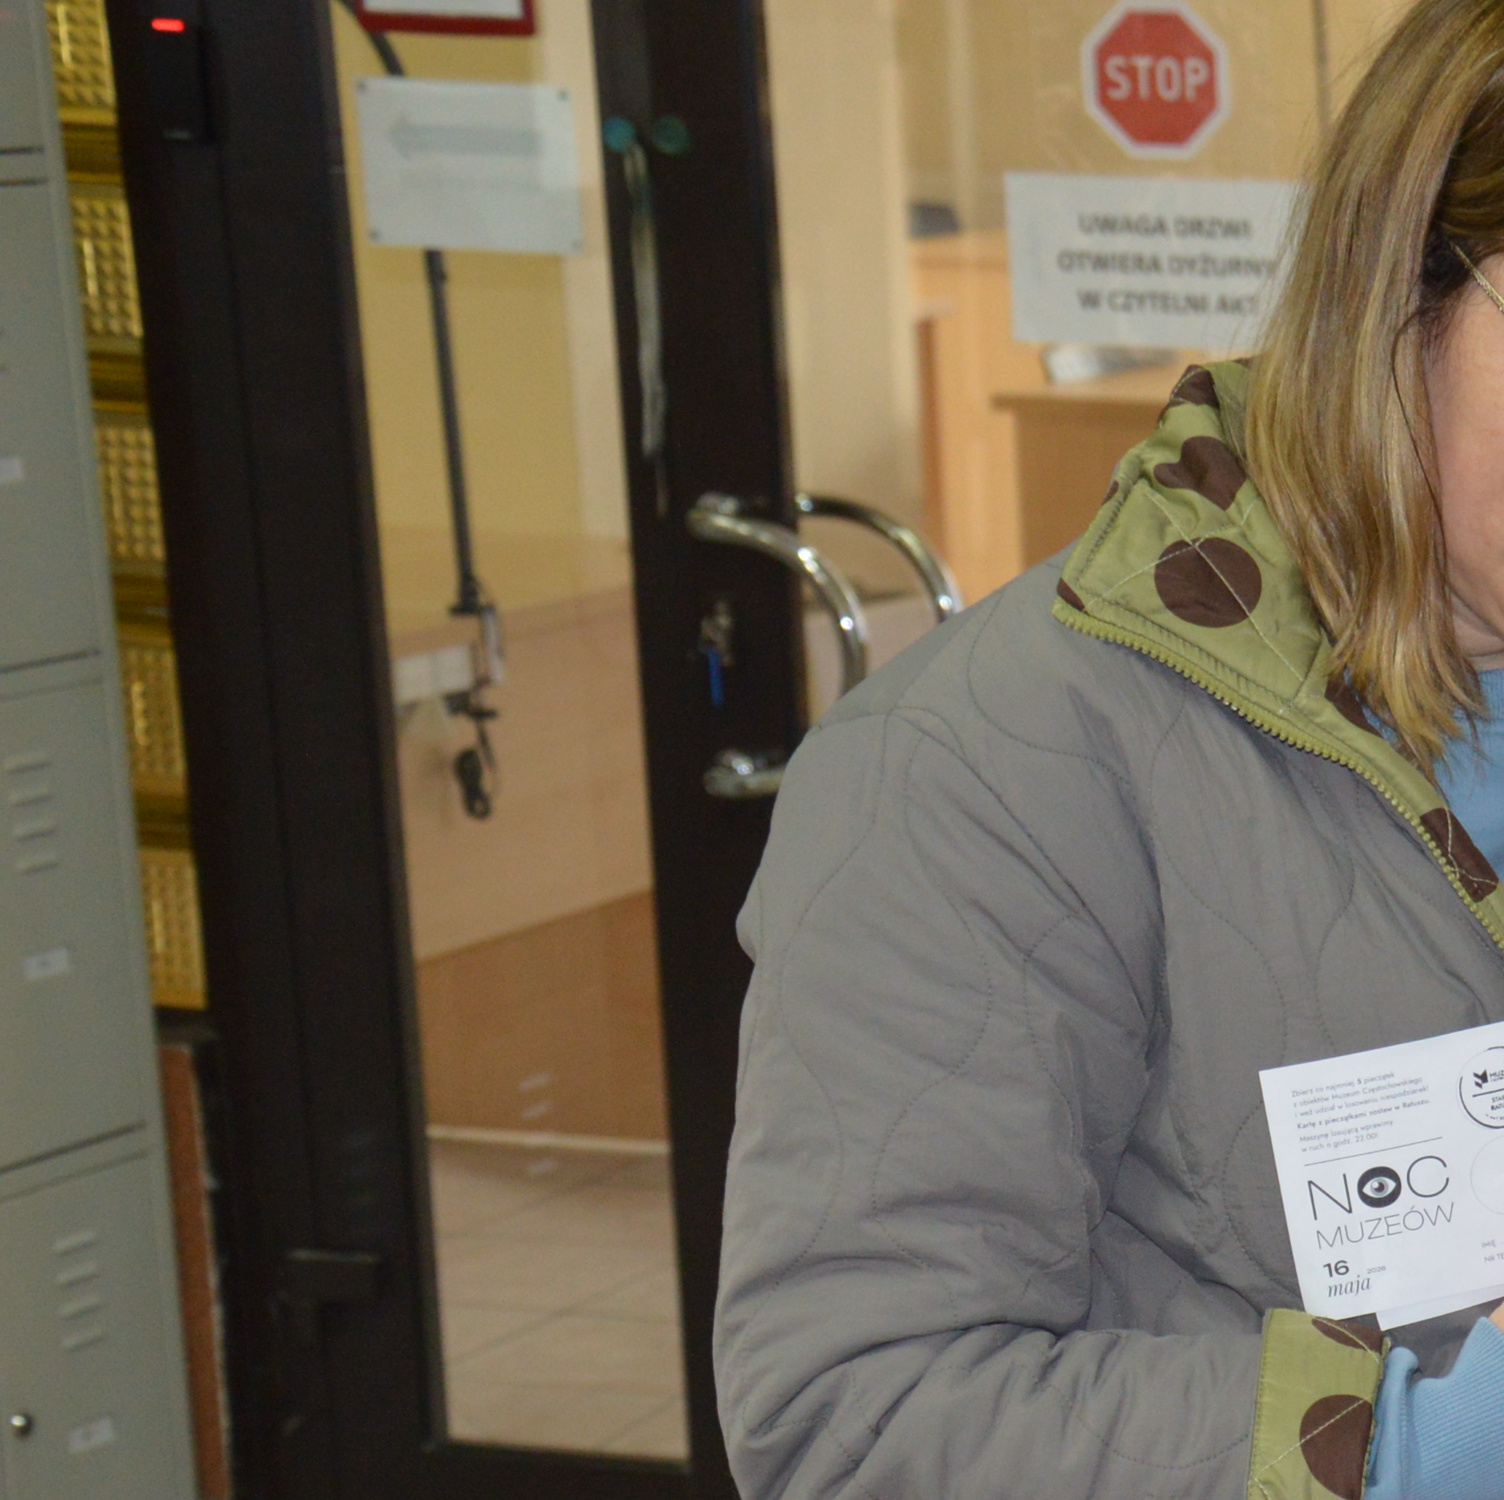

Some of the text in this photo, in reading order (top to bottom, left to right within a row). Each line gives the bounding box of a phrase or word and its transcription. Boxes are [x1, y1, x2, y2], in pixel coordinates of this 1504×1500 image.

[1104, 55, 1210, 101] STOP
[1078, 213, 1250, 240] UWAGA DRZWI
[1057, 251, 1161, 274] OTWIERA
[1077, 290, 1102, 311] W
[1106, 291, 1207, 313] CZYTELNI
[1291, 1088, 1314, 1098] Zbierz
[1315, 1086, 1324, 1094] co
[1357, 1078, 1362, 1086] 5
[1364, 1071, 1395, 1086] pieczątek
[1299, 1095, 1330, 1107] obiektów
[1331, 1089, 1360, 1101] Muzeum
[1362, 1077, 1423, 1095] Częstochowskiego
[1297, 1121, 1316, 1130] Kartę
[1325, 1111, 1367, 1127] pieczątkami
[1369, 1106, 1393, 1116] zostaw
[1299, 1120, 1394, 1143] Maszynę losującą wprawimy
[1309, 1142, 1325, 1152] ruch
[1316, 1201, 1454, 1250] MUZEÓW
[1481, 1239, 1496, 1249] IMIĘ
[1322, 1260, 1350, 1278] 16
[1484, 1254, 1495, 1263] NR
[1328, 1265, 1387, 1298] maja 2026
